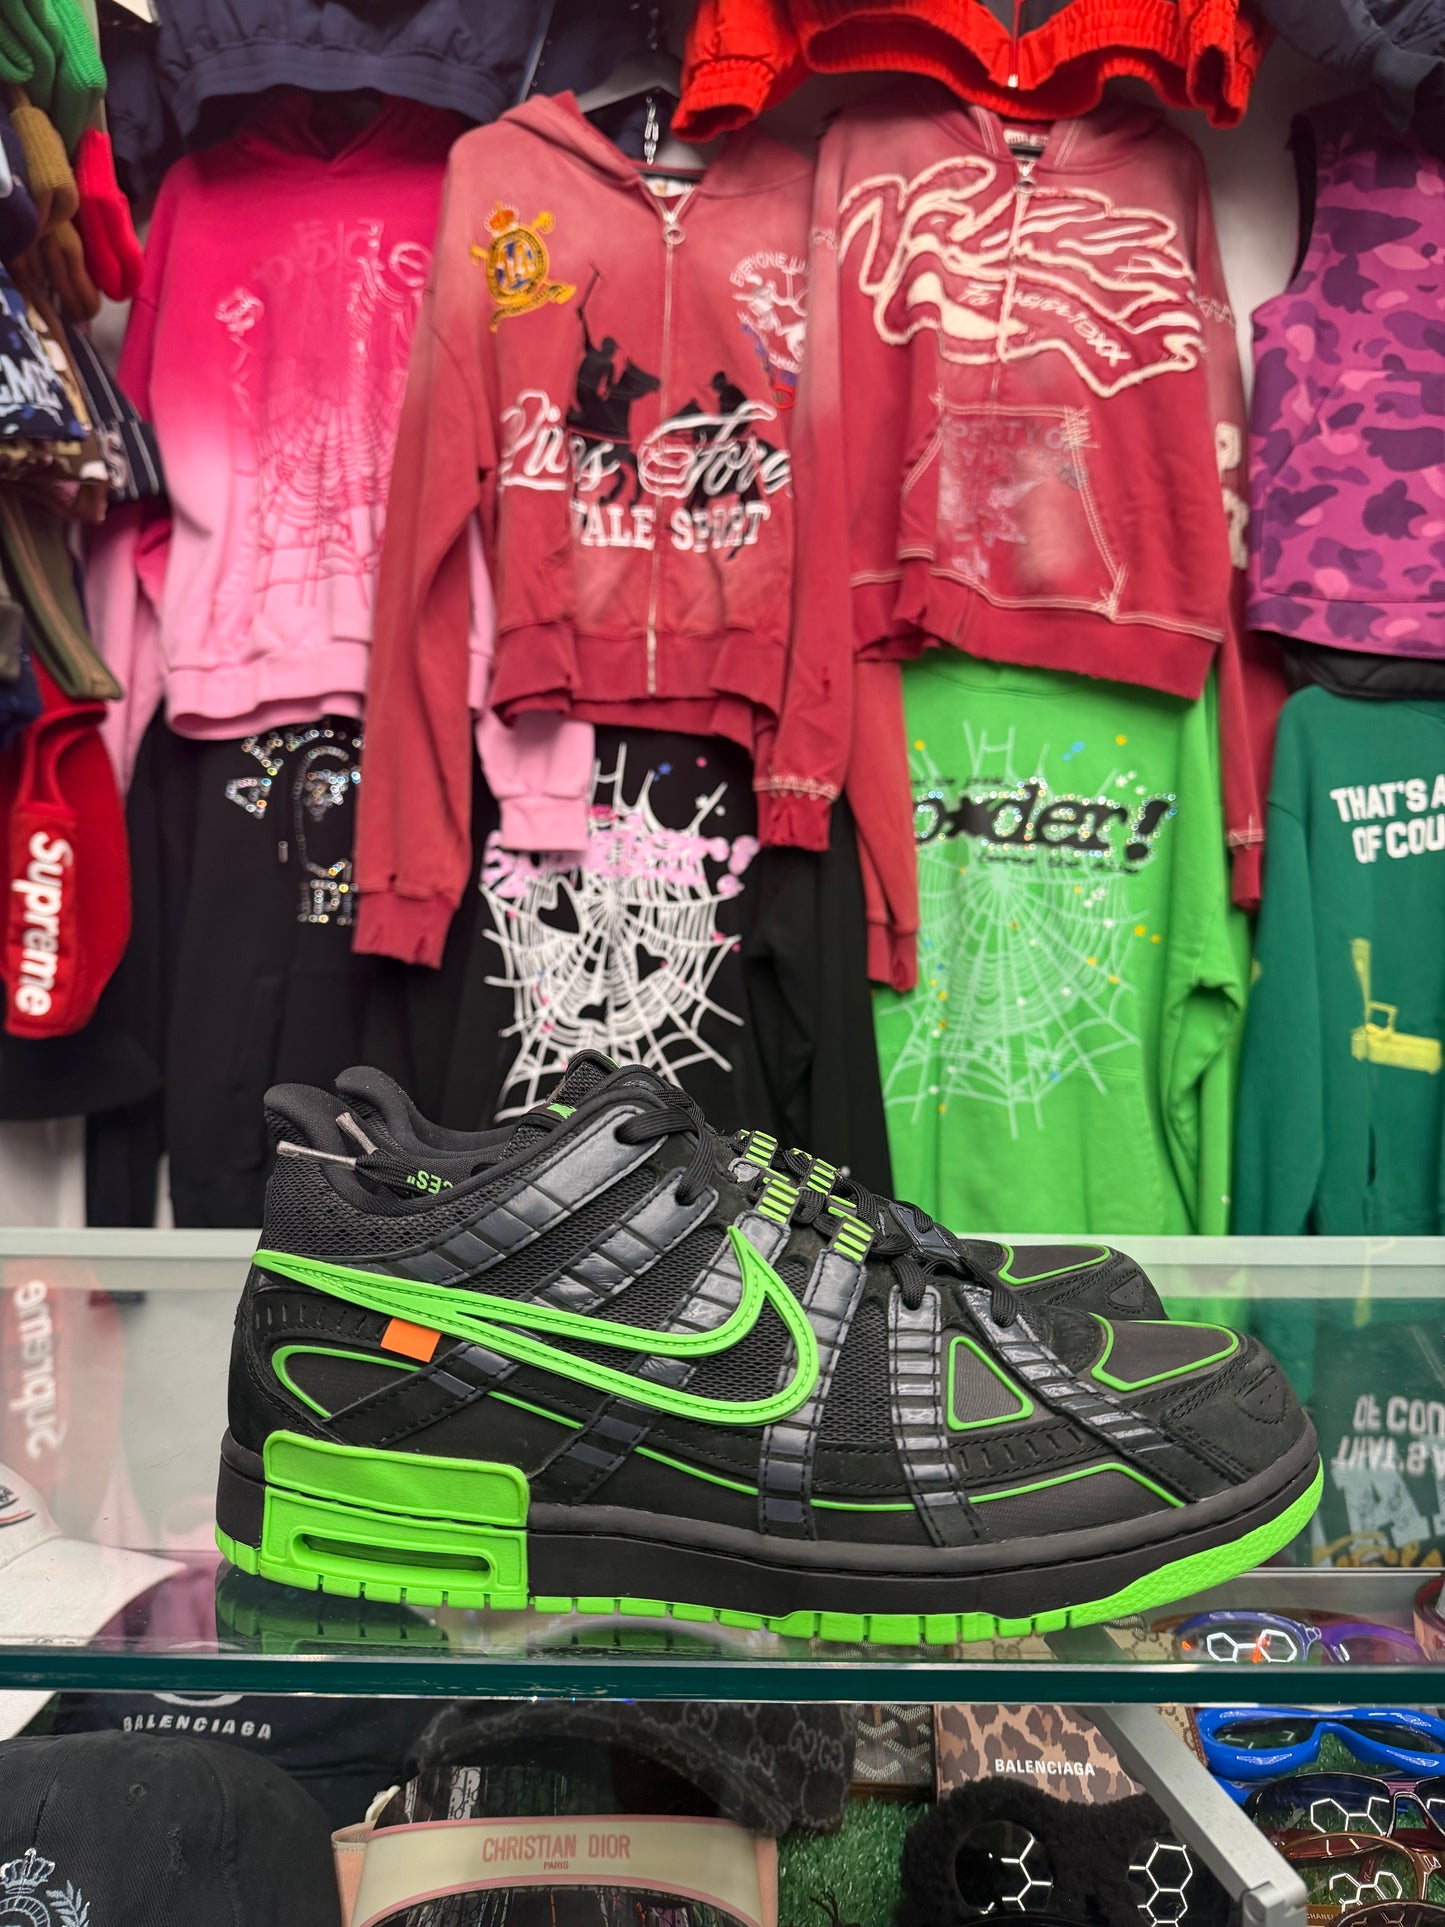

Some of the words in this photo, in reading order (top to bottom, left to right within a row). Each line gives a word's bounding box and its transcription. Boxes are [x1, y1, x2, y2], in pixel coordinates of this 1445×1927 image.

[1329, 778, 1427, 823] THAT'S
[1352, 824, 1382, 864] OF
[11, 831, 74, 1016] Supreme
[123, 1714, 272, 1740] BALENCIAGA
[994, 1758, 1096, 1777] BALENCIAGA
[482, 1834, 577, 1863] CHRISTIAN
[587, 1833, 632, 1860] DIOR
[543, 1860, 570, 1870] PARIS
